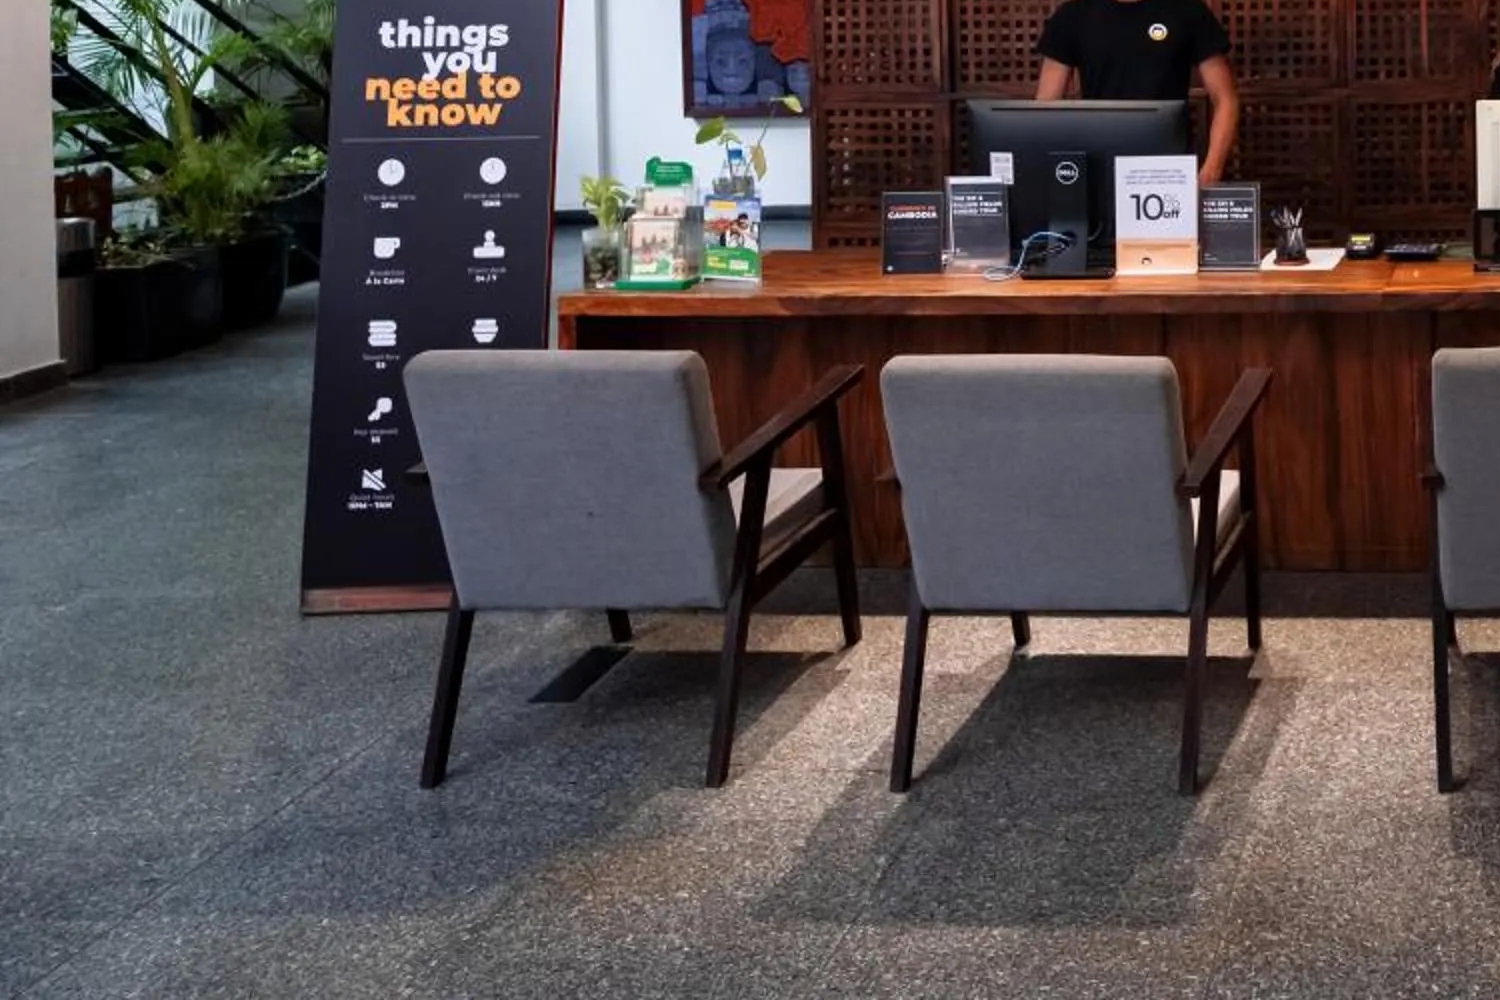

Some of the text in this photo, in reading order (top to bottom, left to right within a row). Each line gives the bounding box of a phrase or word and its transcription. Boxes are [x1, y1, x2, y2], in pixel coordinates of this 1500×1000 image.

[378, 15, 509, 53] things
[422, 50, 497, 81] you
[365, 72, 522, 101] need to
[387, 99, 503, 128] know
[1059, 169, 1076, 177] DELL
[887, 210, 939, 219] CAMBODIA
[1129, 193, 1164, 221] 10
[1163, 208, 1180, 219] off
